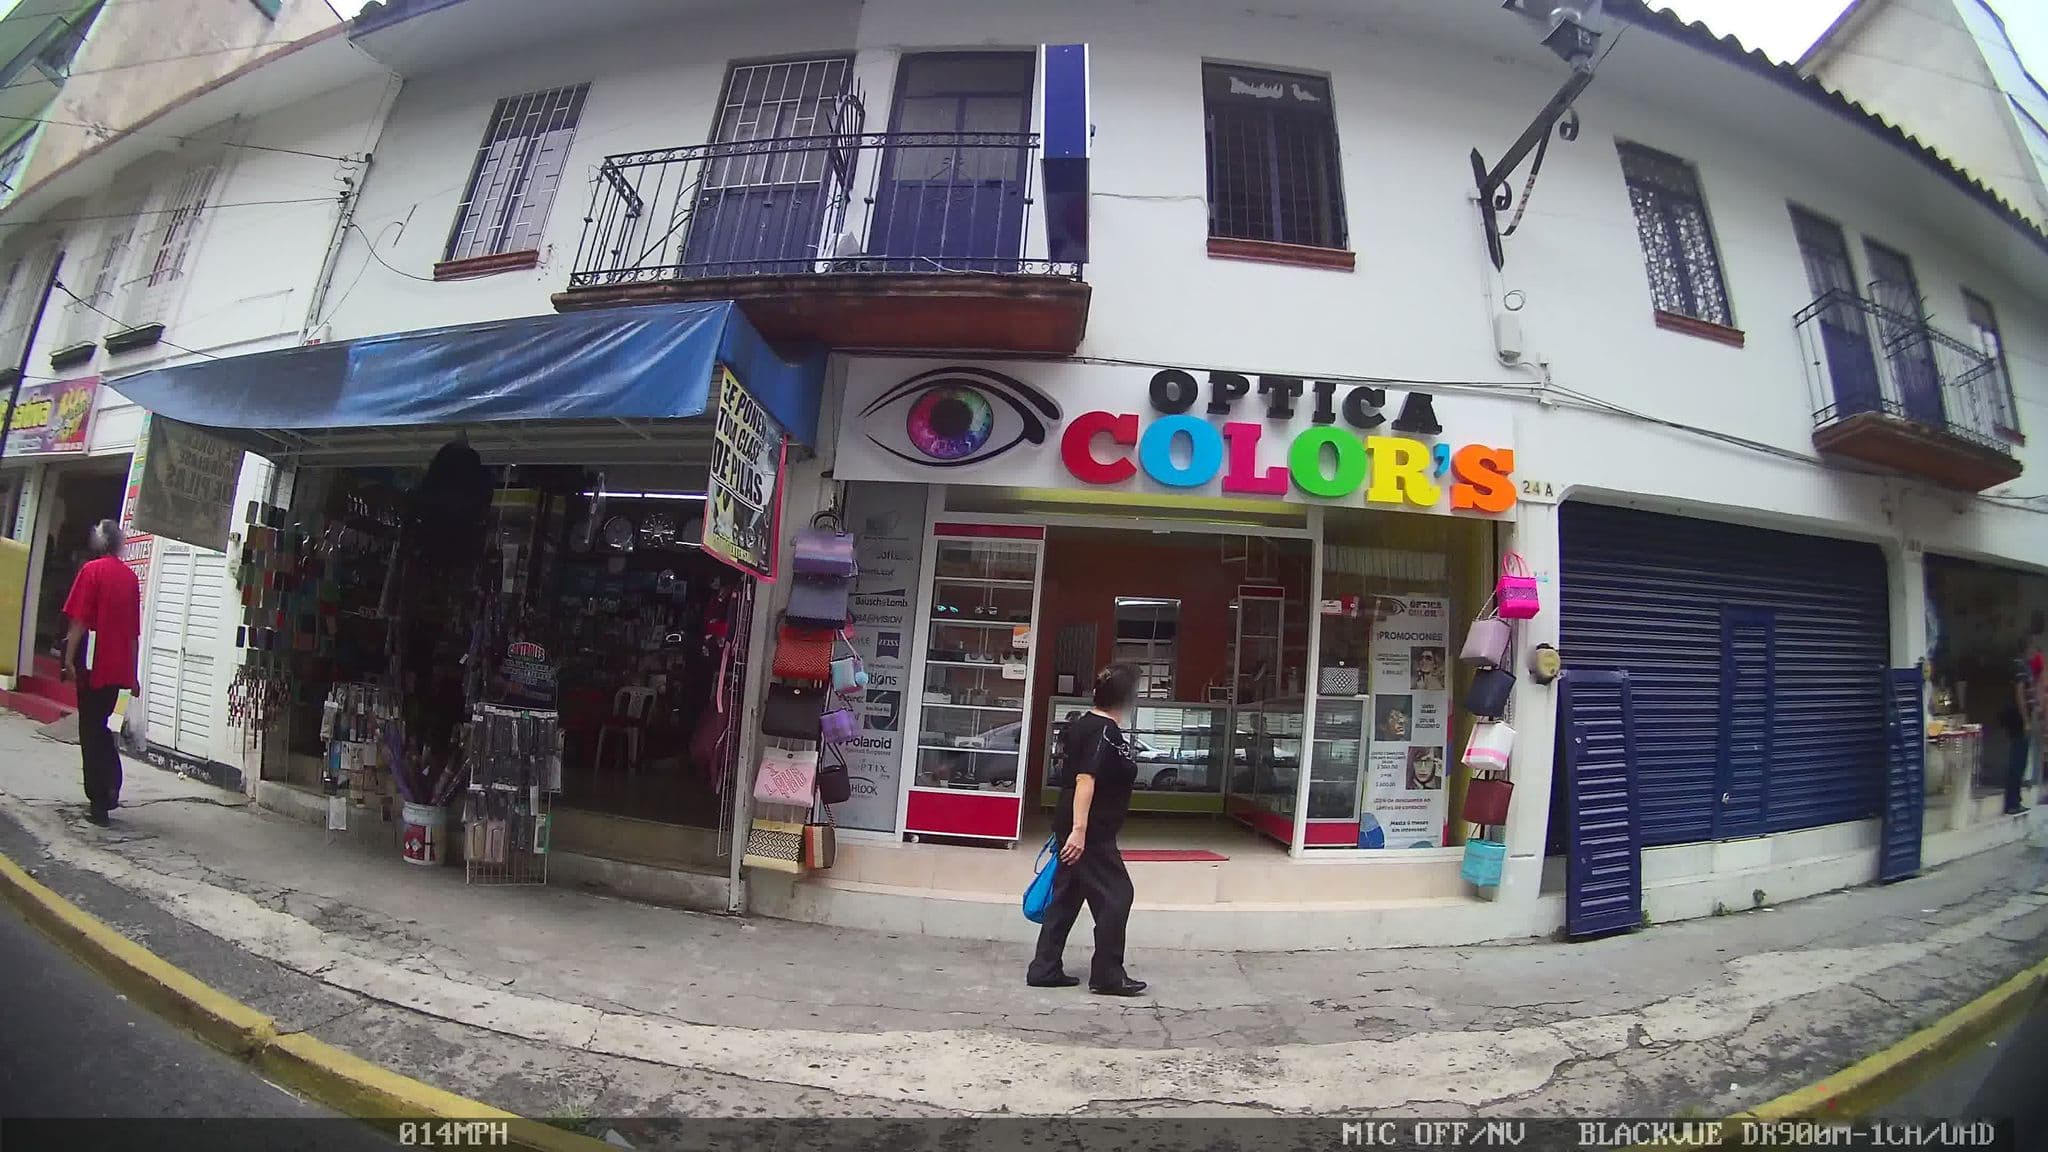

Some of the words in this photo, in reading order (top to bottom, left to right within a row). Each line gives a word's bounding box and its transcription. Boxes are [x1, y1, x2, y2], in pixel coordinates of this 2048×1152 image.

[1149, 368, 1443, 435] OPTICA
[712, 436, 731, 480] DE
[730, 454, 763, 506] PILAS
[1060, 410, 1517, 514] COLOR'S
[879, 639, 900, 647] ZEISS
[851, 783, 878, 795] HLOOK
